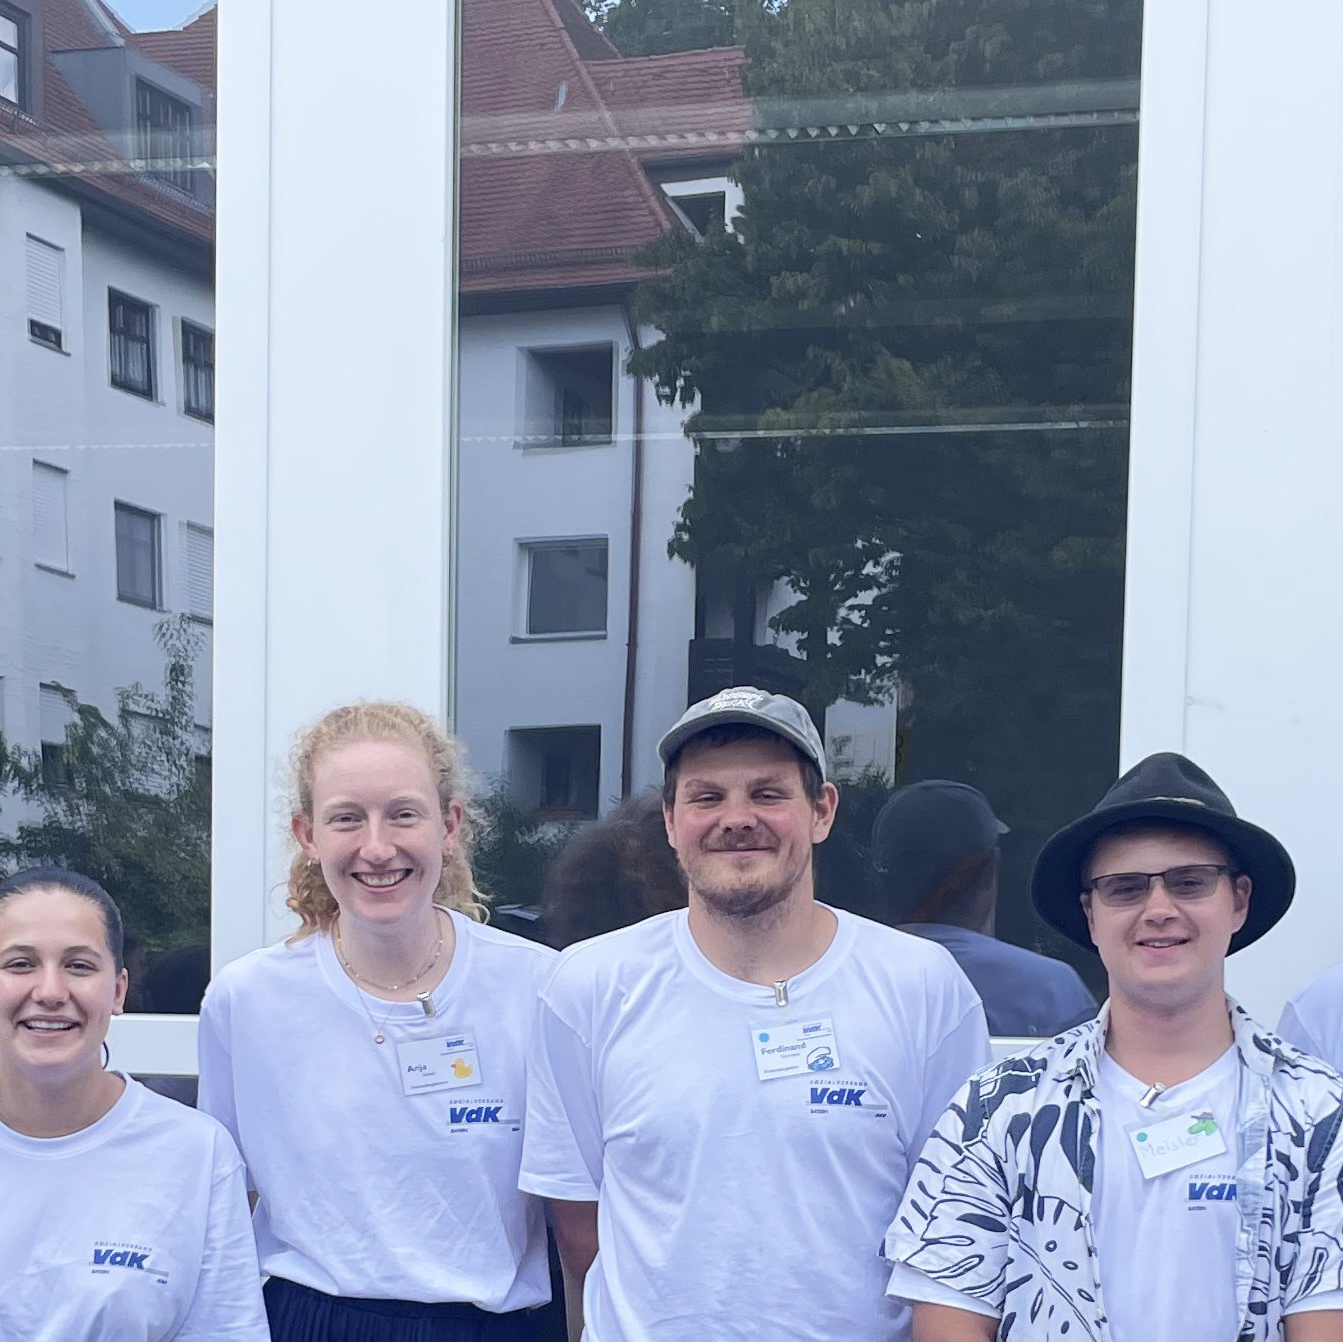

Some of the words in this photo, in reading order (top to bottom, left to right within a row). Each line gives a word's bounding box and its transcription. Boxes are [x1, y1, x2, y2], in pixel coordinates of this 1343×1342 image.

[761, 1042, 806, 1056] Ferdinand
[810, 1087, 866, 1107] VdK
[449, 1106, 503, 1124] VdK
[92, 1248, 151, 1270] VdK
